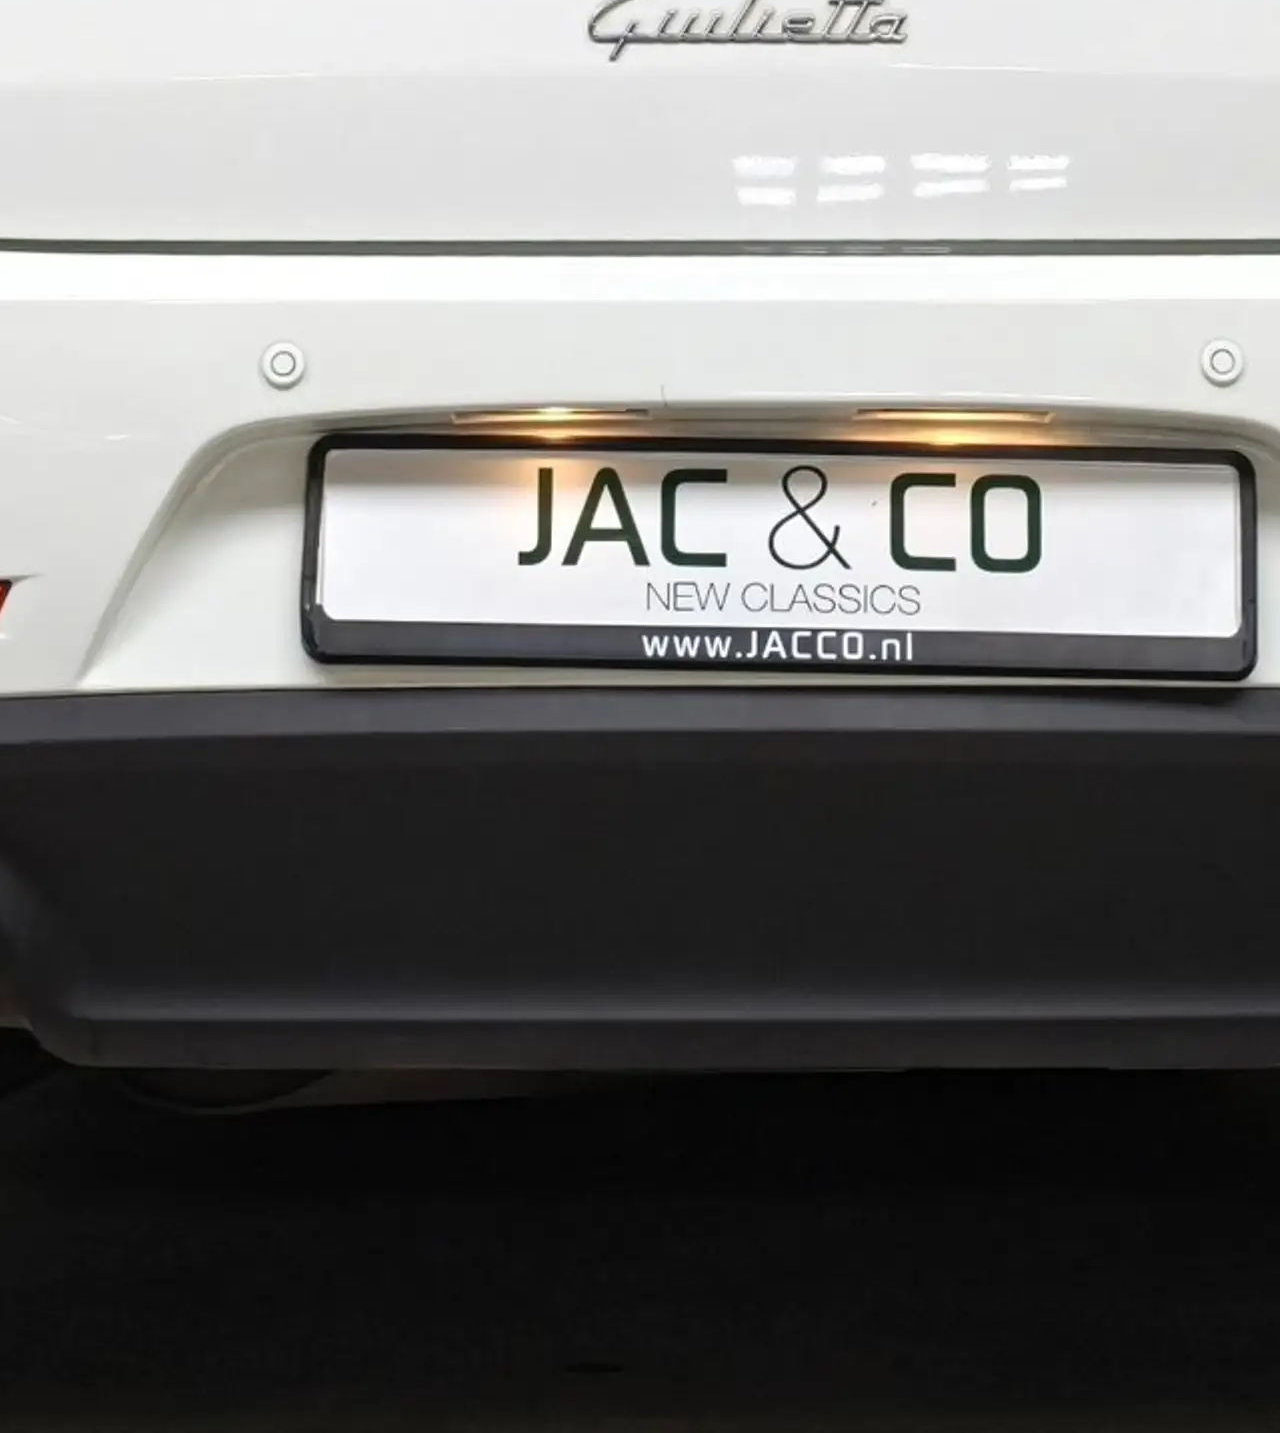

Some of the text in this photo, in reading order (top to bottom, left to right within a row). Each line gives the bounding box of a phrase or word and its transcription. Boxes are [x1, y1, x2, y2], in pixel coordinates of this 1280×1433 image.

[518, 465, 1042, 574] JAC & CO
[645, 581, 921, 616] NEW CLASSICS
[642, 629, 914, 662] www.JACCO.nl
